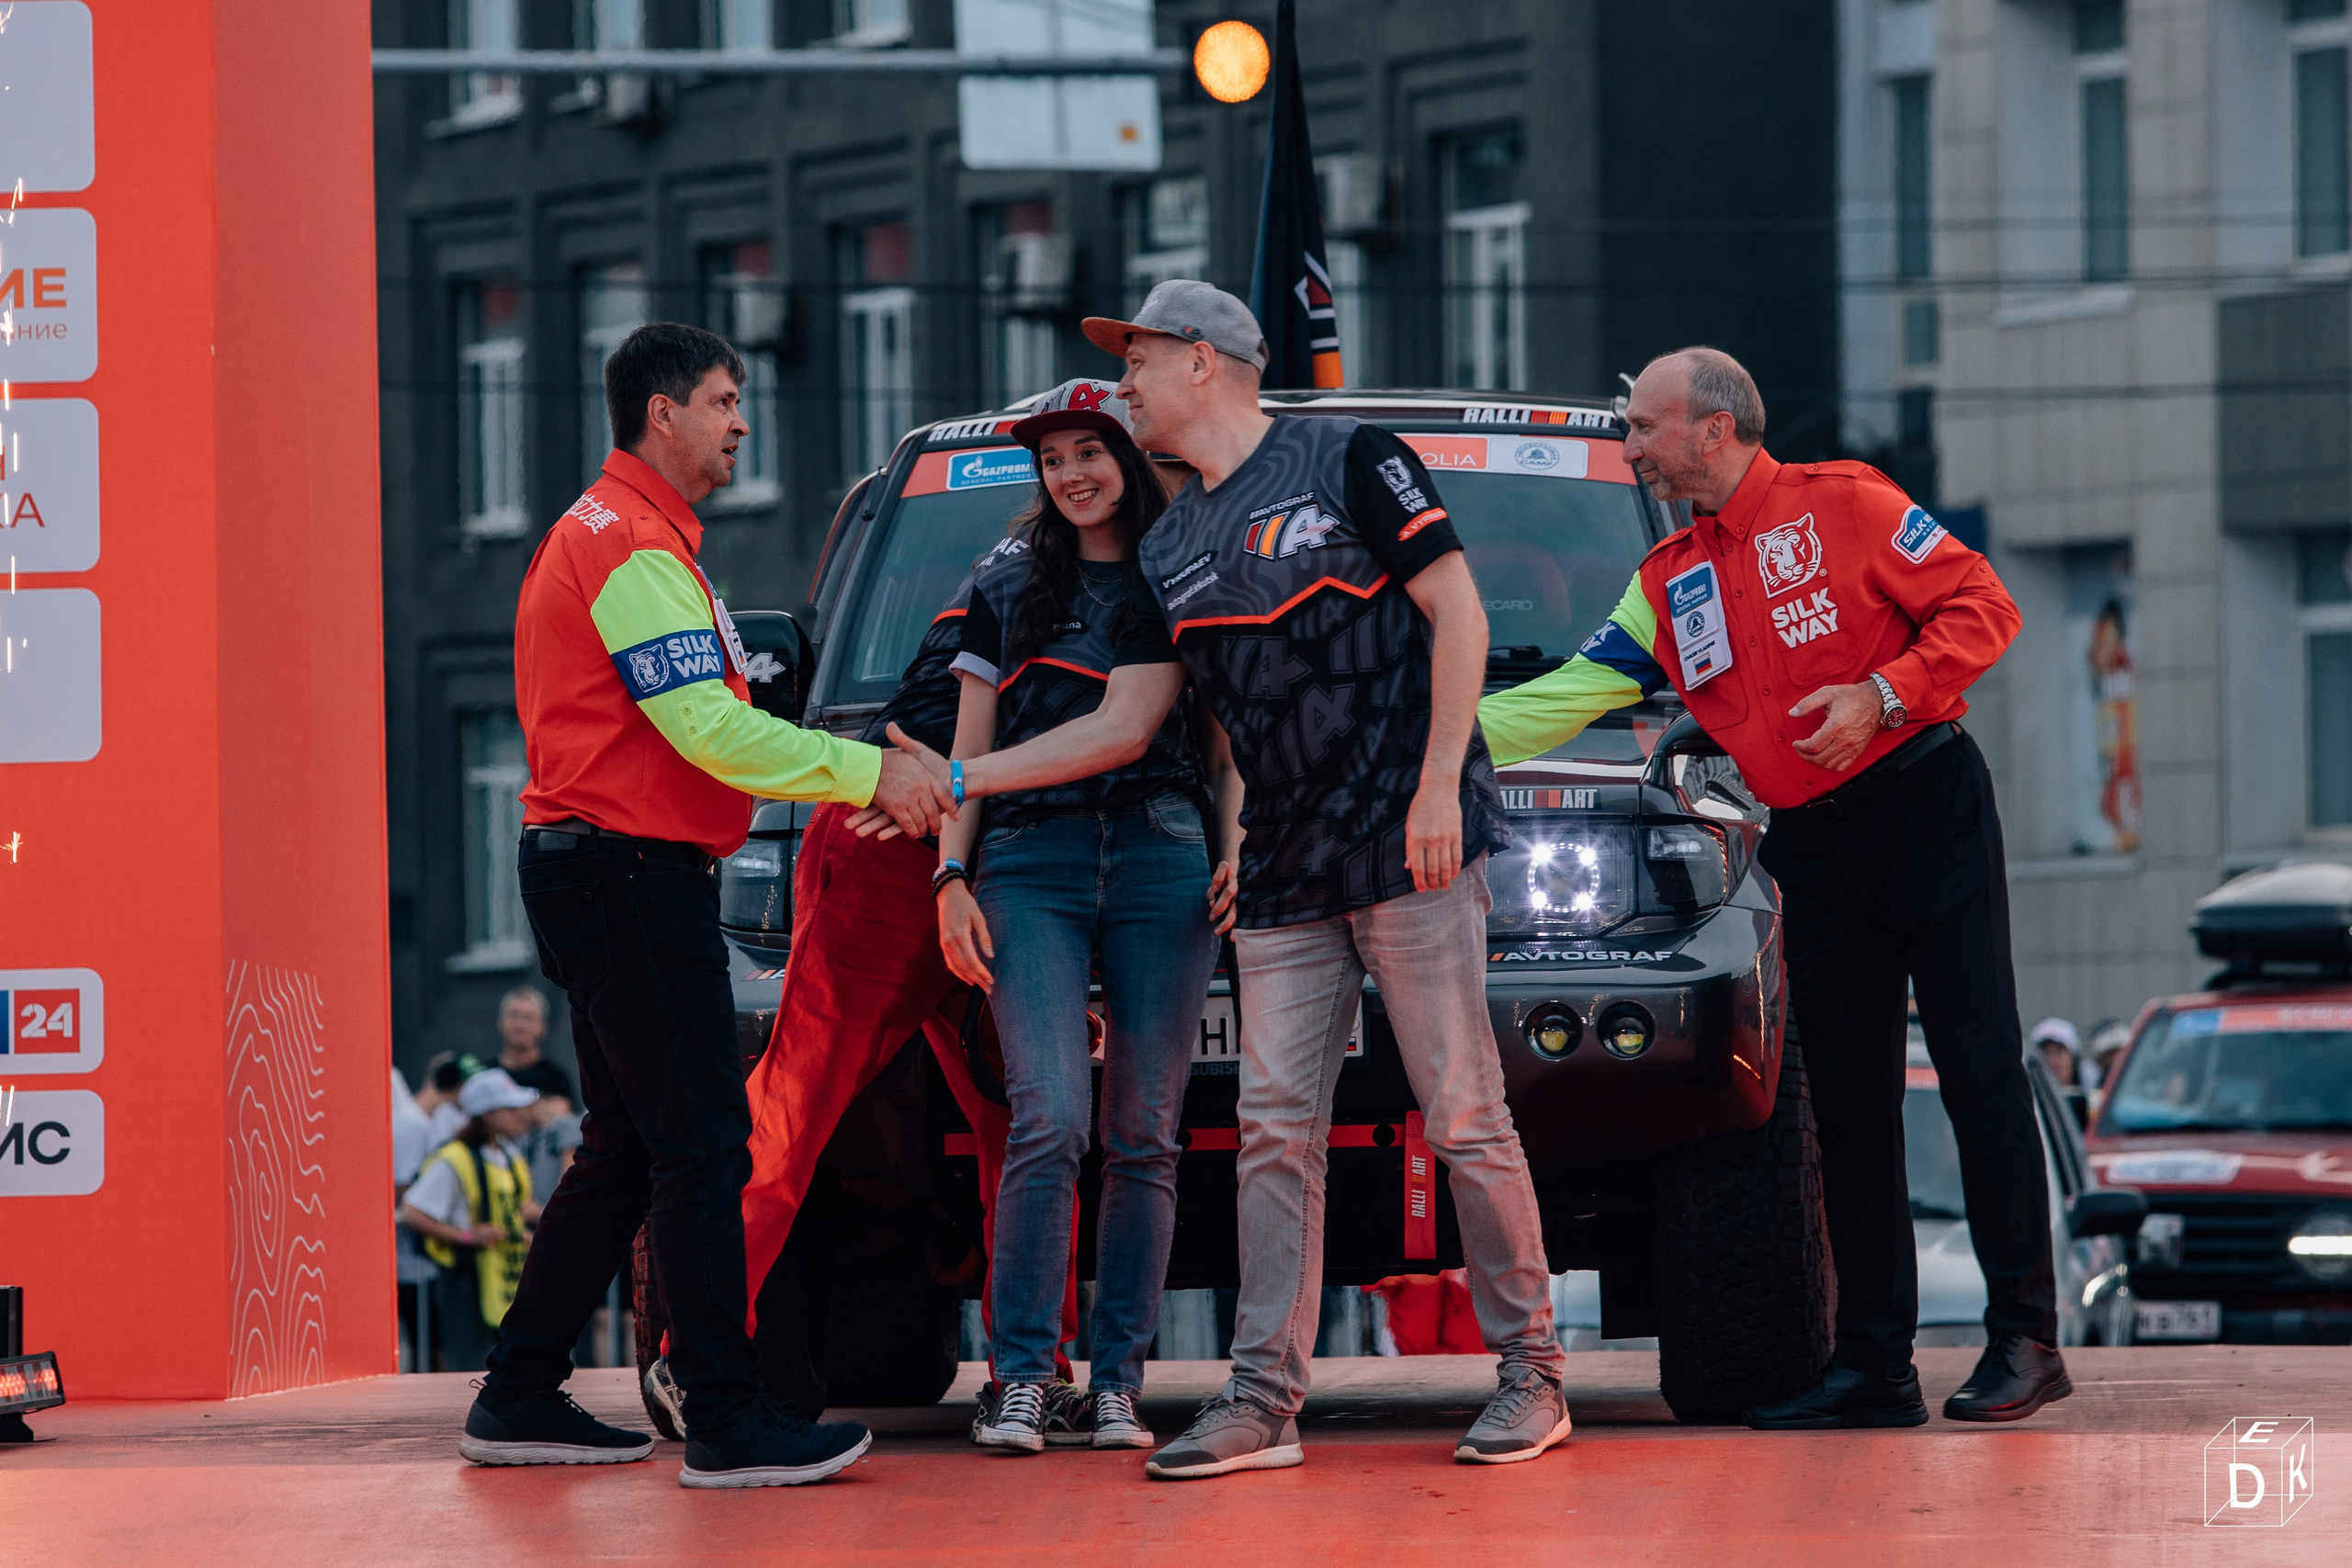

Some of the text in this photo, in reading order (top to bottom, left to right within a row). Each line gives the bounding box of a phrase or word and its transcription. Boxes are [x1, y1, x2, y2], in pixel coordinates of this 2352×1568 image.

[1463, 408, 1613, 428] RALLI ART
[927, 422, 999, 442] RALLI
[982, 463, 1031, 477] GAZPROM
[1397, 488, 1424, 506] SILK
[1903, 519, 1928, 547] SILK
[1482, 600, 1533, 611] ECARO
[1771, 587, 1837, 629] SILK
[1777, 608, 1838, 649] WAY
[666, 635, 717, 659] SILK
[672, 654, 721, 678] WAY
[1562, 788, 1598, 808] ART
[1503, 951, 1673, 961] AVTOGRAF
[20, 1002, 74, 1038] 24
[1411, 1155, 1426, 1218] RALLI ART
